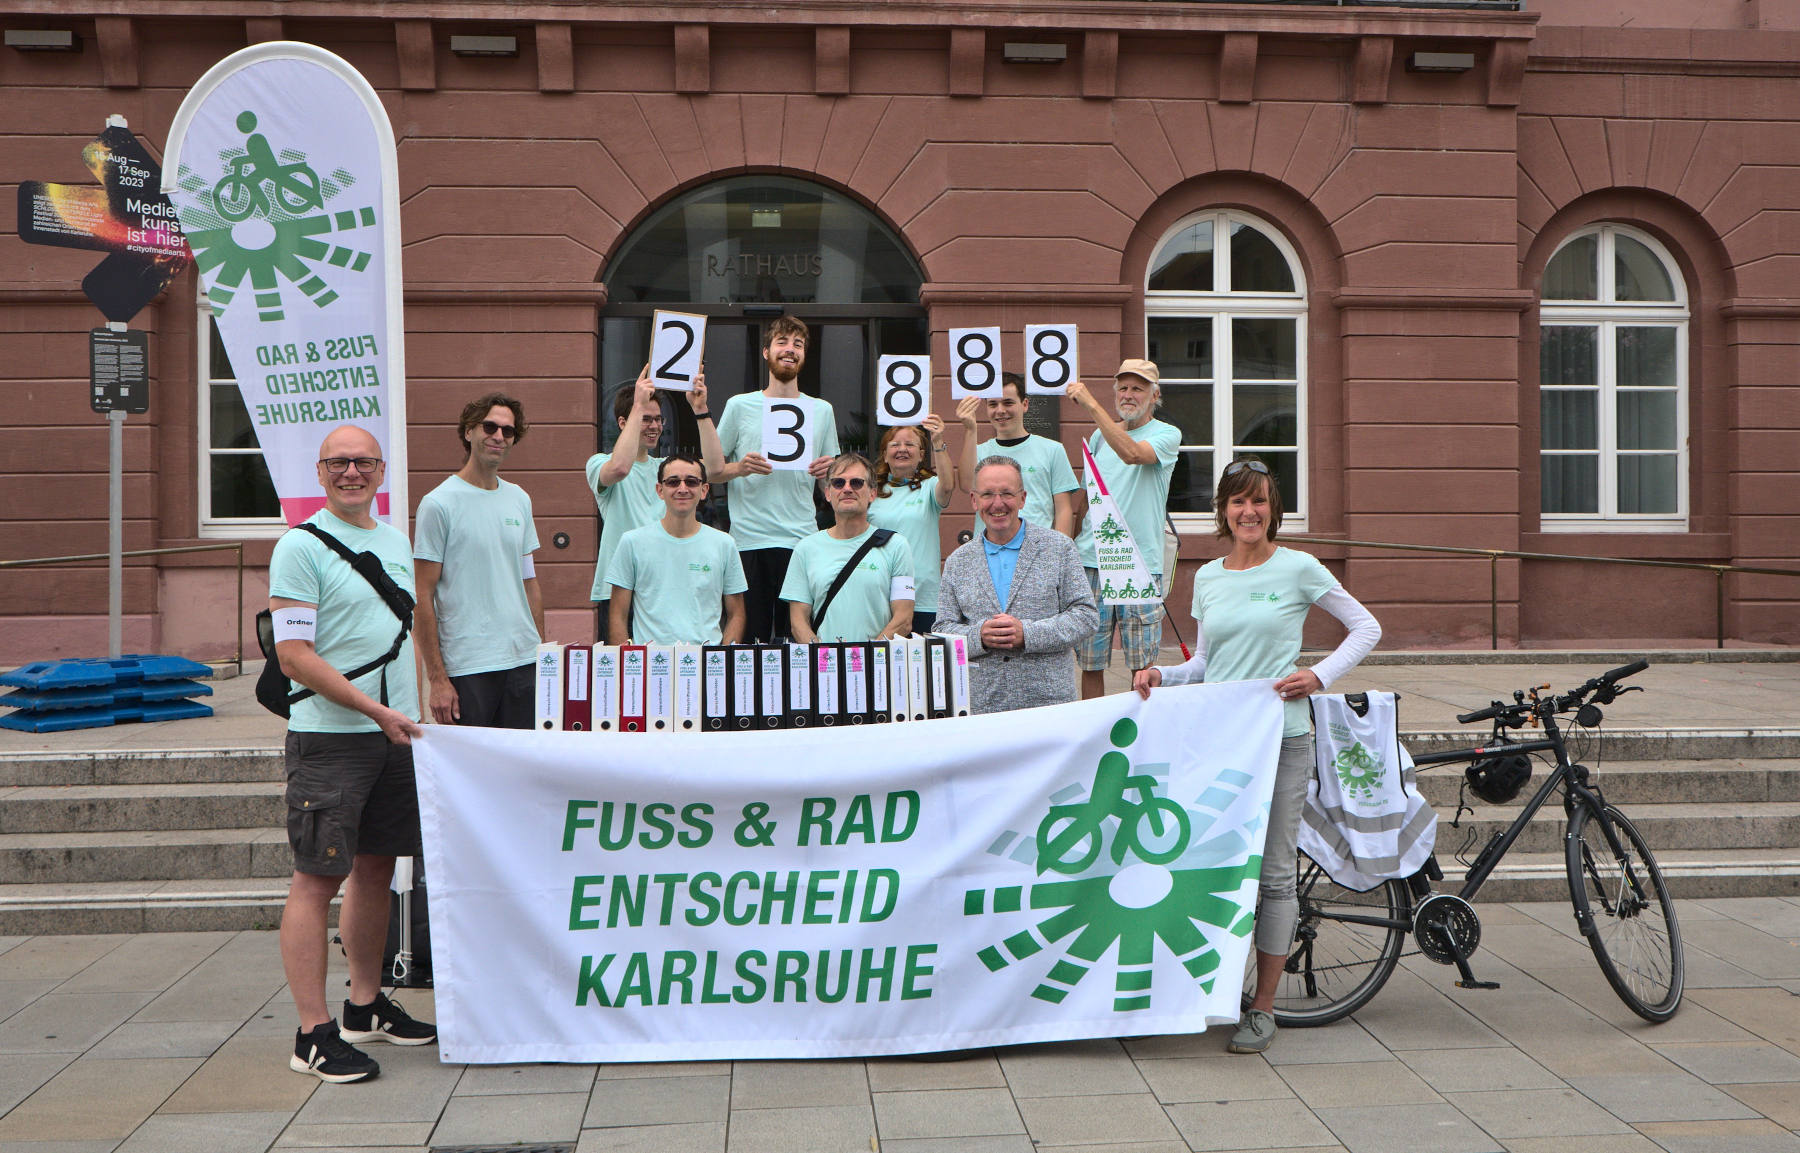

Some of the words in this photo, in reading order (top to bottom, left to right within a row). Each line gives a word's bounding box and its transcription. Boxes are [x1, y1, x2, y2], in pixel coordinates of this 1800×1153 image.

[107, 153, 127, 165] Aug
[119, 165, 129, 174] 17
[131, 167, 150, 179] Sep
[119, 176, 144, 188] 2023
[126, 198, 177, 218] Medie
[142, 215, 181, 232] kuns
[127, 227, 147, 243] ist
[156, 231, 186, 247] hier
[126, 244, 186, 257] #cityofmediaarts
[706, 254, 824, 277] RATHAUS
[655, 320, 695, 382] 2
[956, 333, 995, 391] 8
[1031, 329, 1070, 388] 8
[883, 360, 922, 418] 8
[767, 403, 806, 462] 3
[286, 619, 314, 627] Ordner
[562, 799, 714, 852] FUSS
[733, 801, 777, 848] &
[797, 789, 921, 846] RAD
[568, 868, 900, 931] ENTSCHEID
[575, 943, 938, 1008] KARLSRUHE
